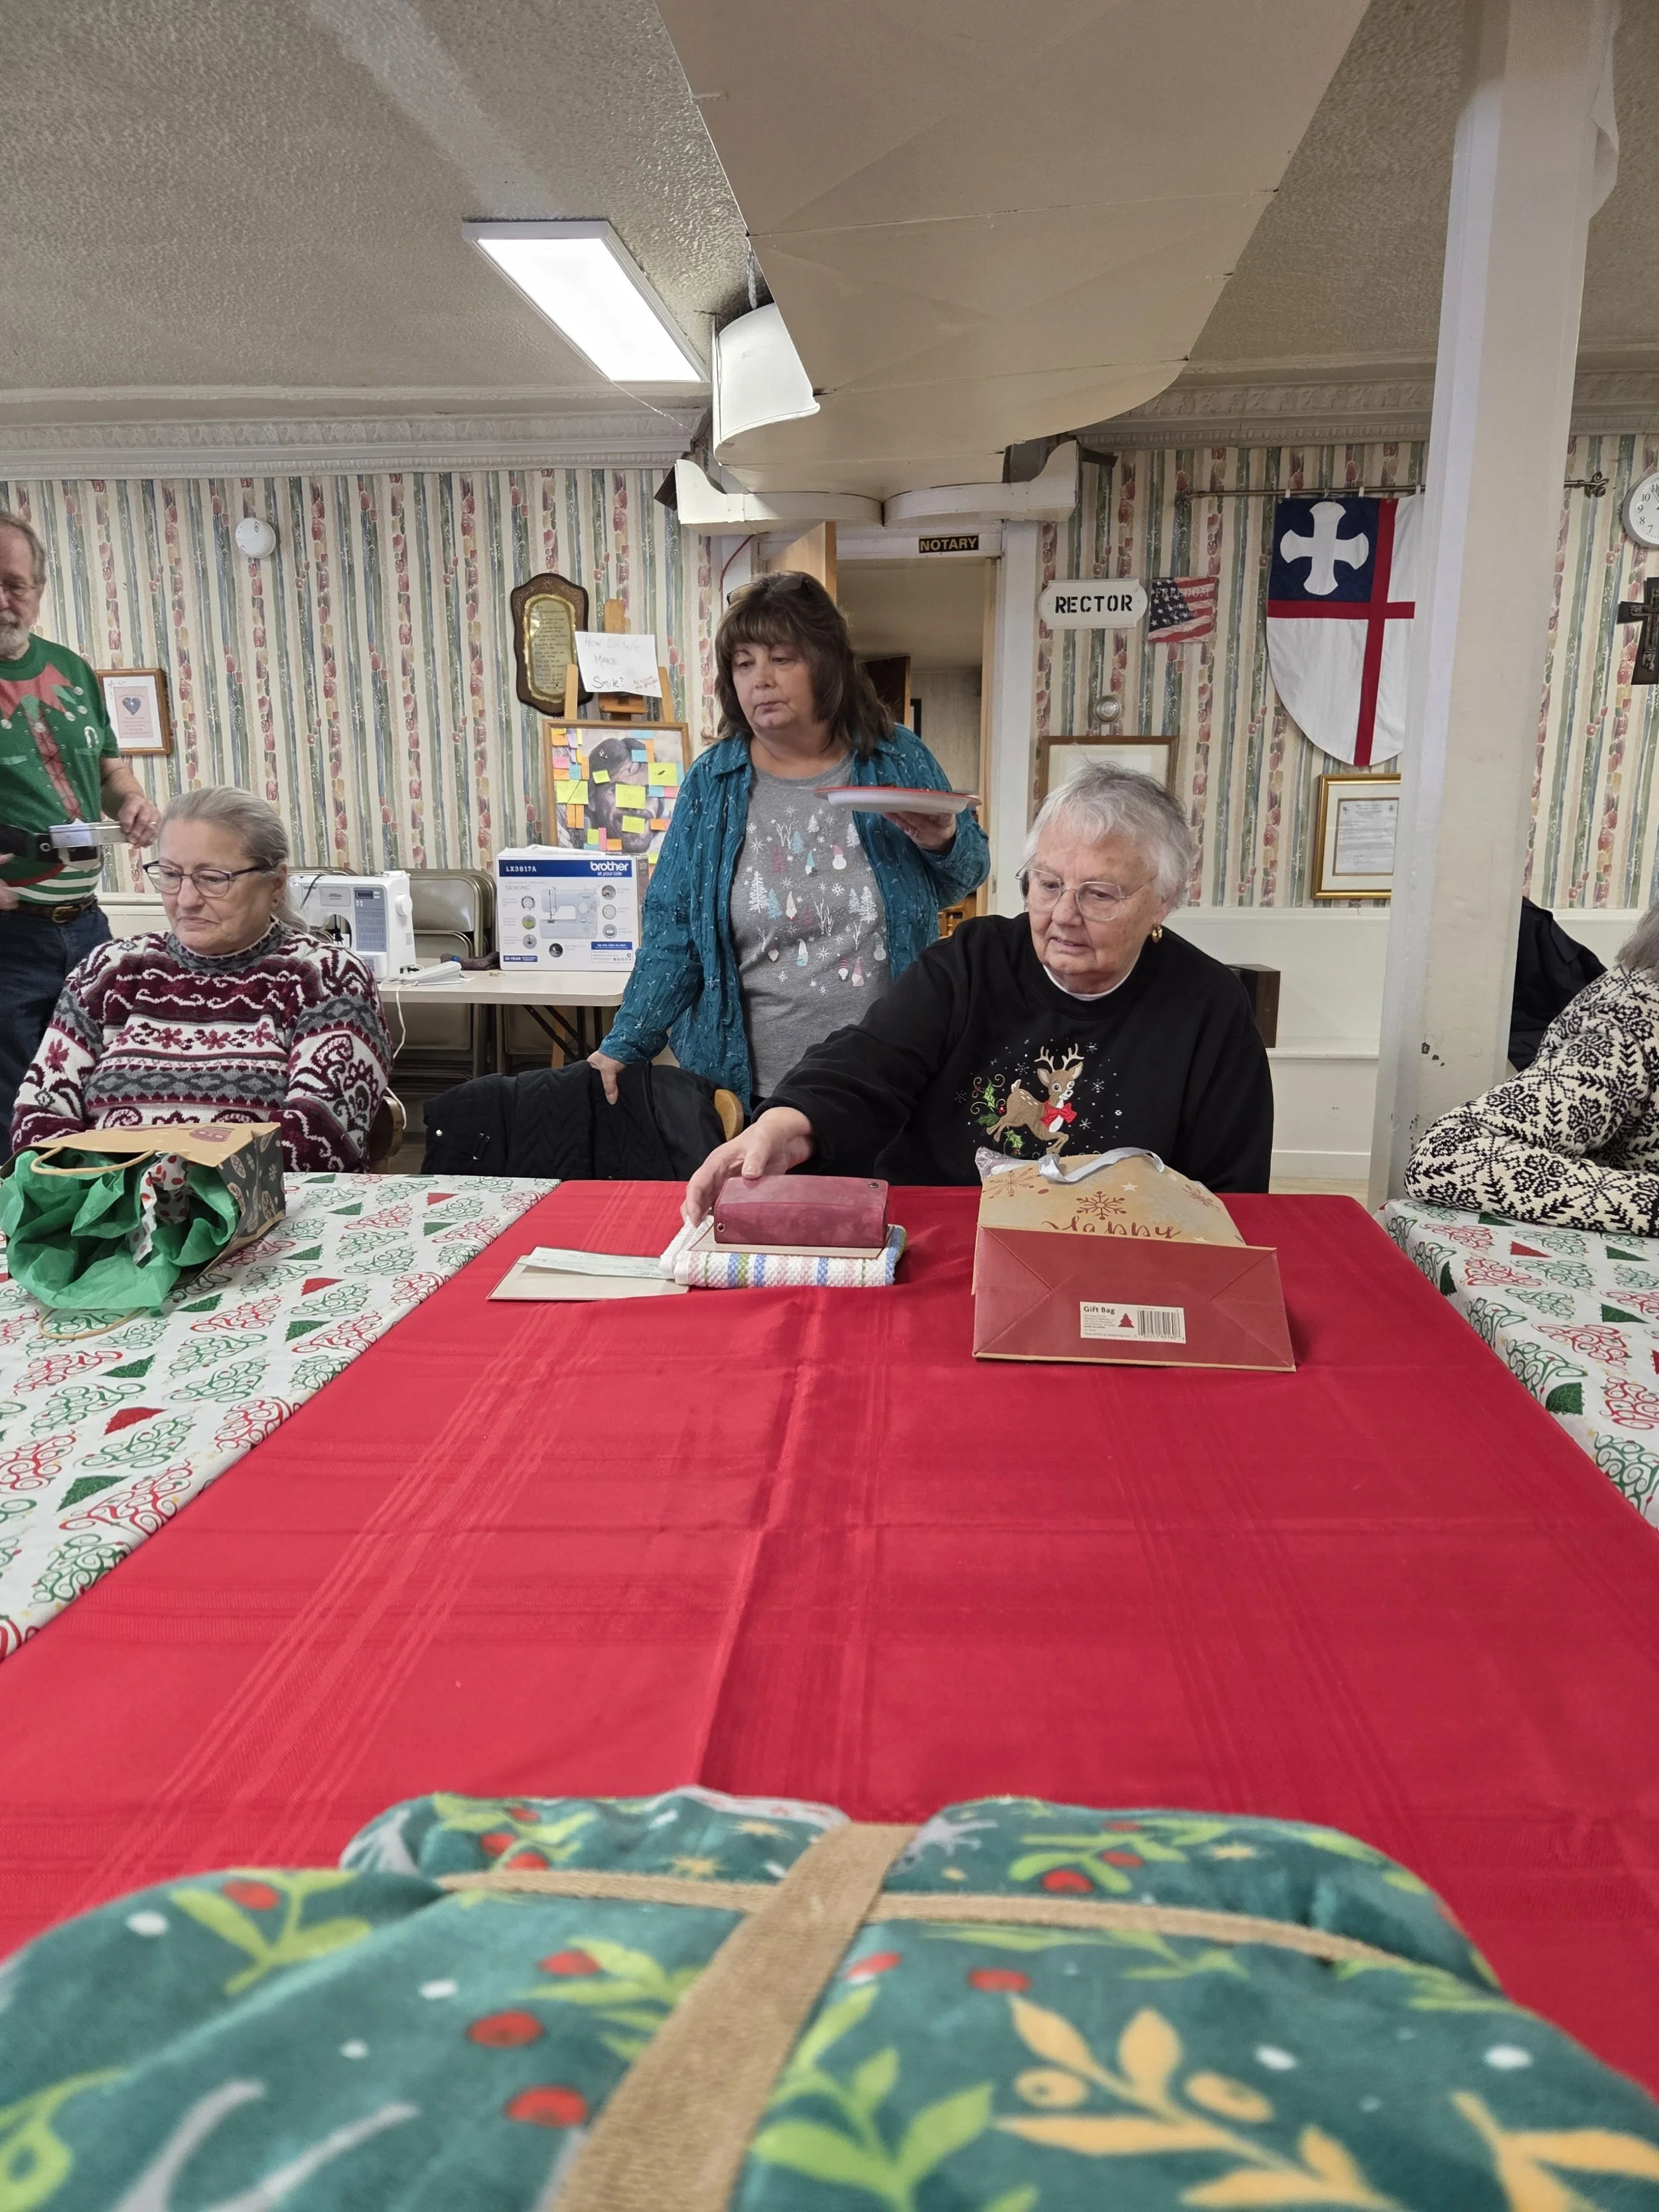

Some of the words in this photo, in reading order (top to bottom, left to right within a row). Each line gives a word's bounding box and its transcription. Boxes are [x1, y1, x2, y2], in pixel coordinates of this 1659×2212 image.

[1642, 493, 1650, 502] 10
[1638, 504, 1644, 513] 9
[920, 537, 977, 552] NOTARY
[1155, 587, 1209, 598] FREEDOM
[1054, 594, 1133, 614] RECTOR
[585, 635, 601, 647] How
[623, 638, 642, 653] We
[595, 654, 620, 668] MAKE
[593, 676, 624, 689] Smile?
[590, 861, 629, 871] brother
[1101, 1306, 1116, 1315] Bag
